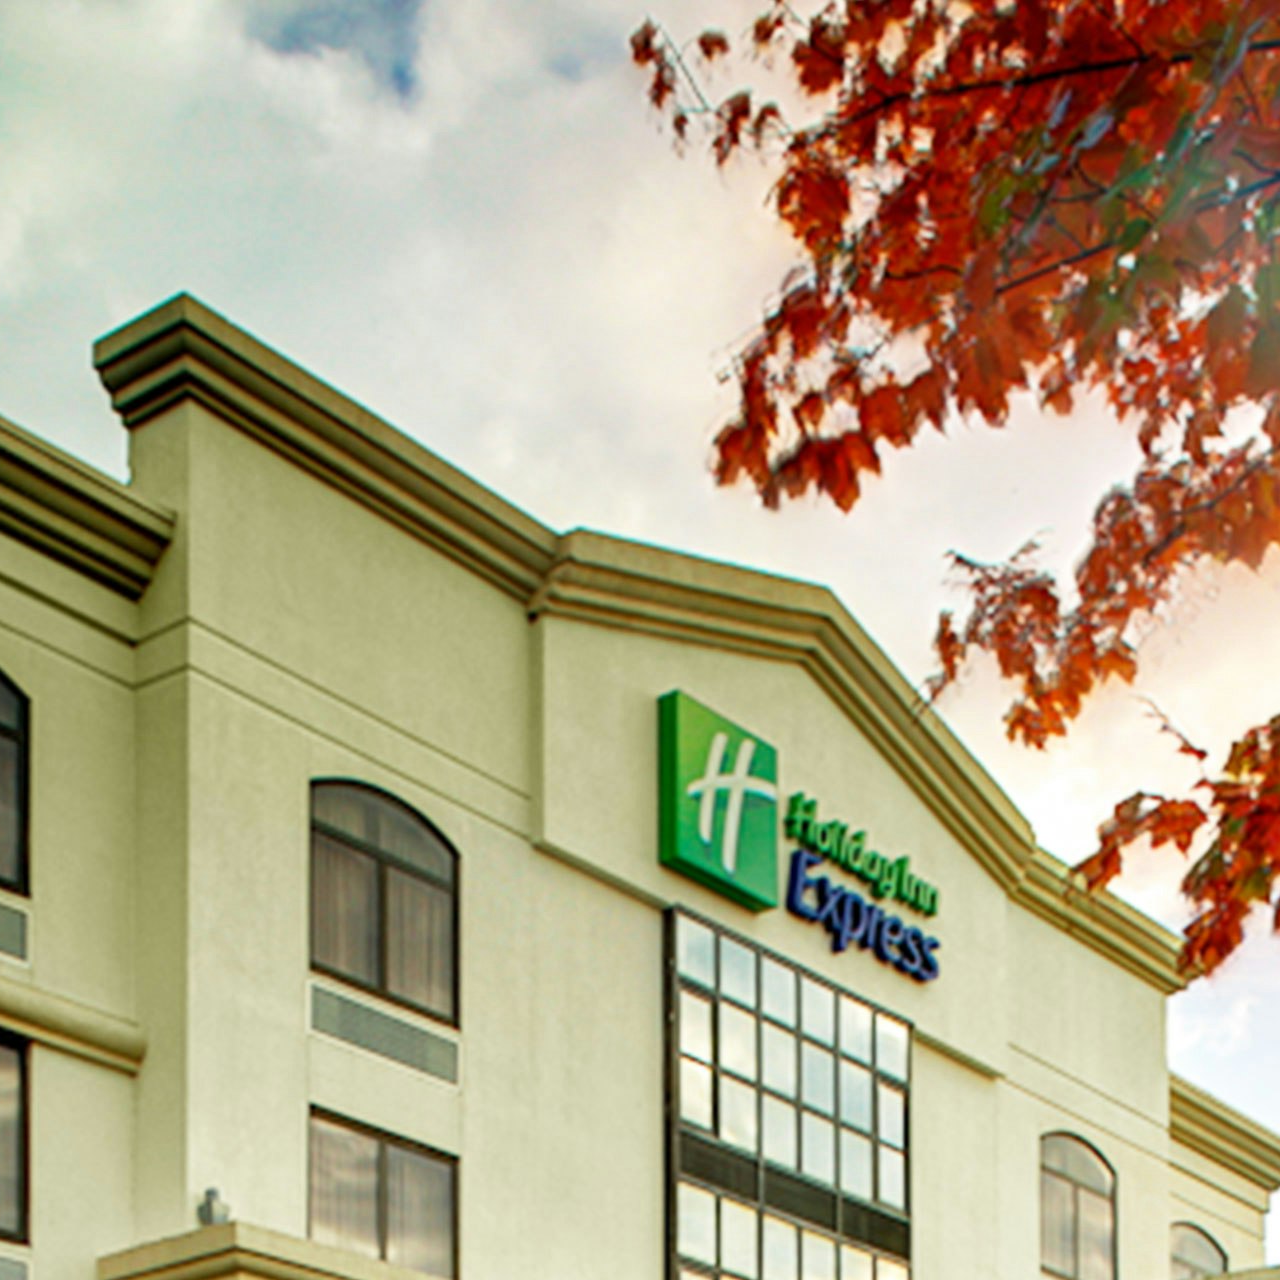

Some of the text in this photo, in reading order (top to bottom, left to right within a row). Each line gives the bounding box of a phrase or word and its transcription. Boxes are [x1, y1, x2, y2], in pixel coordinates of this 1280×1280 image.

[784, 791, 938, 917] Holiday Inn
[786, 849, 940, 983] Express
